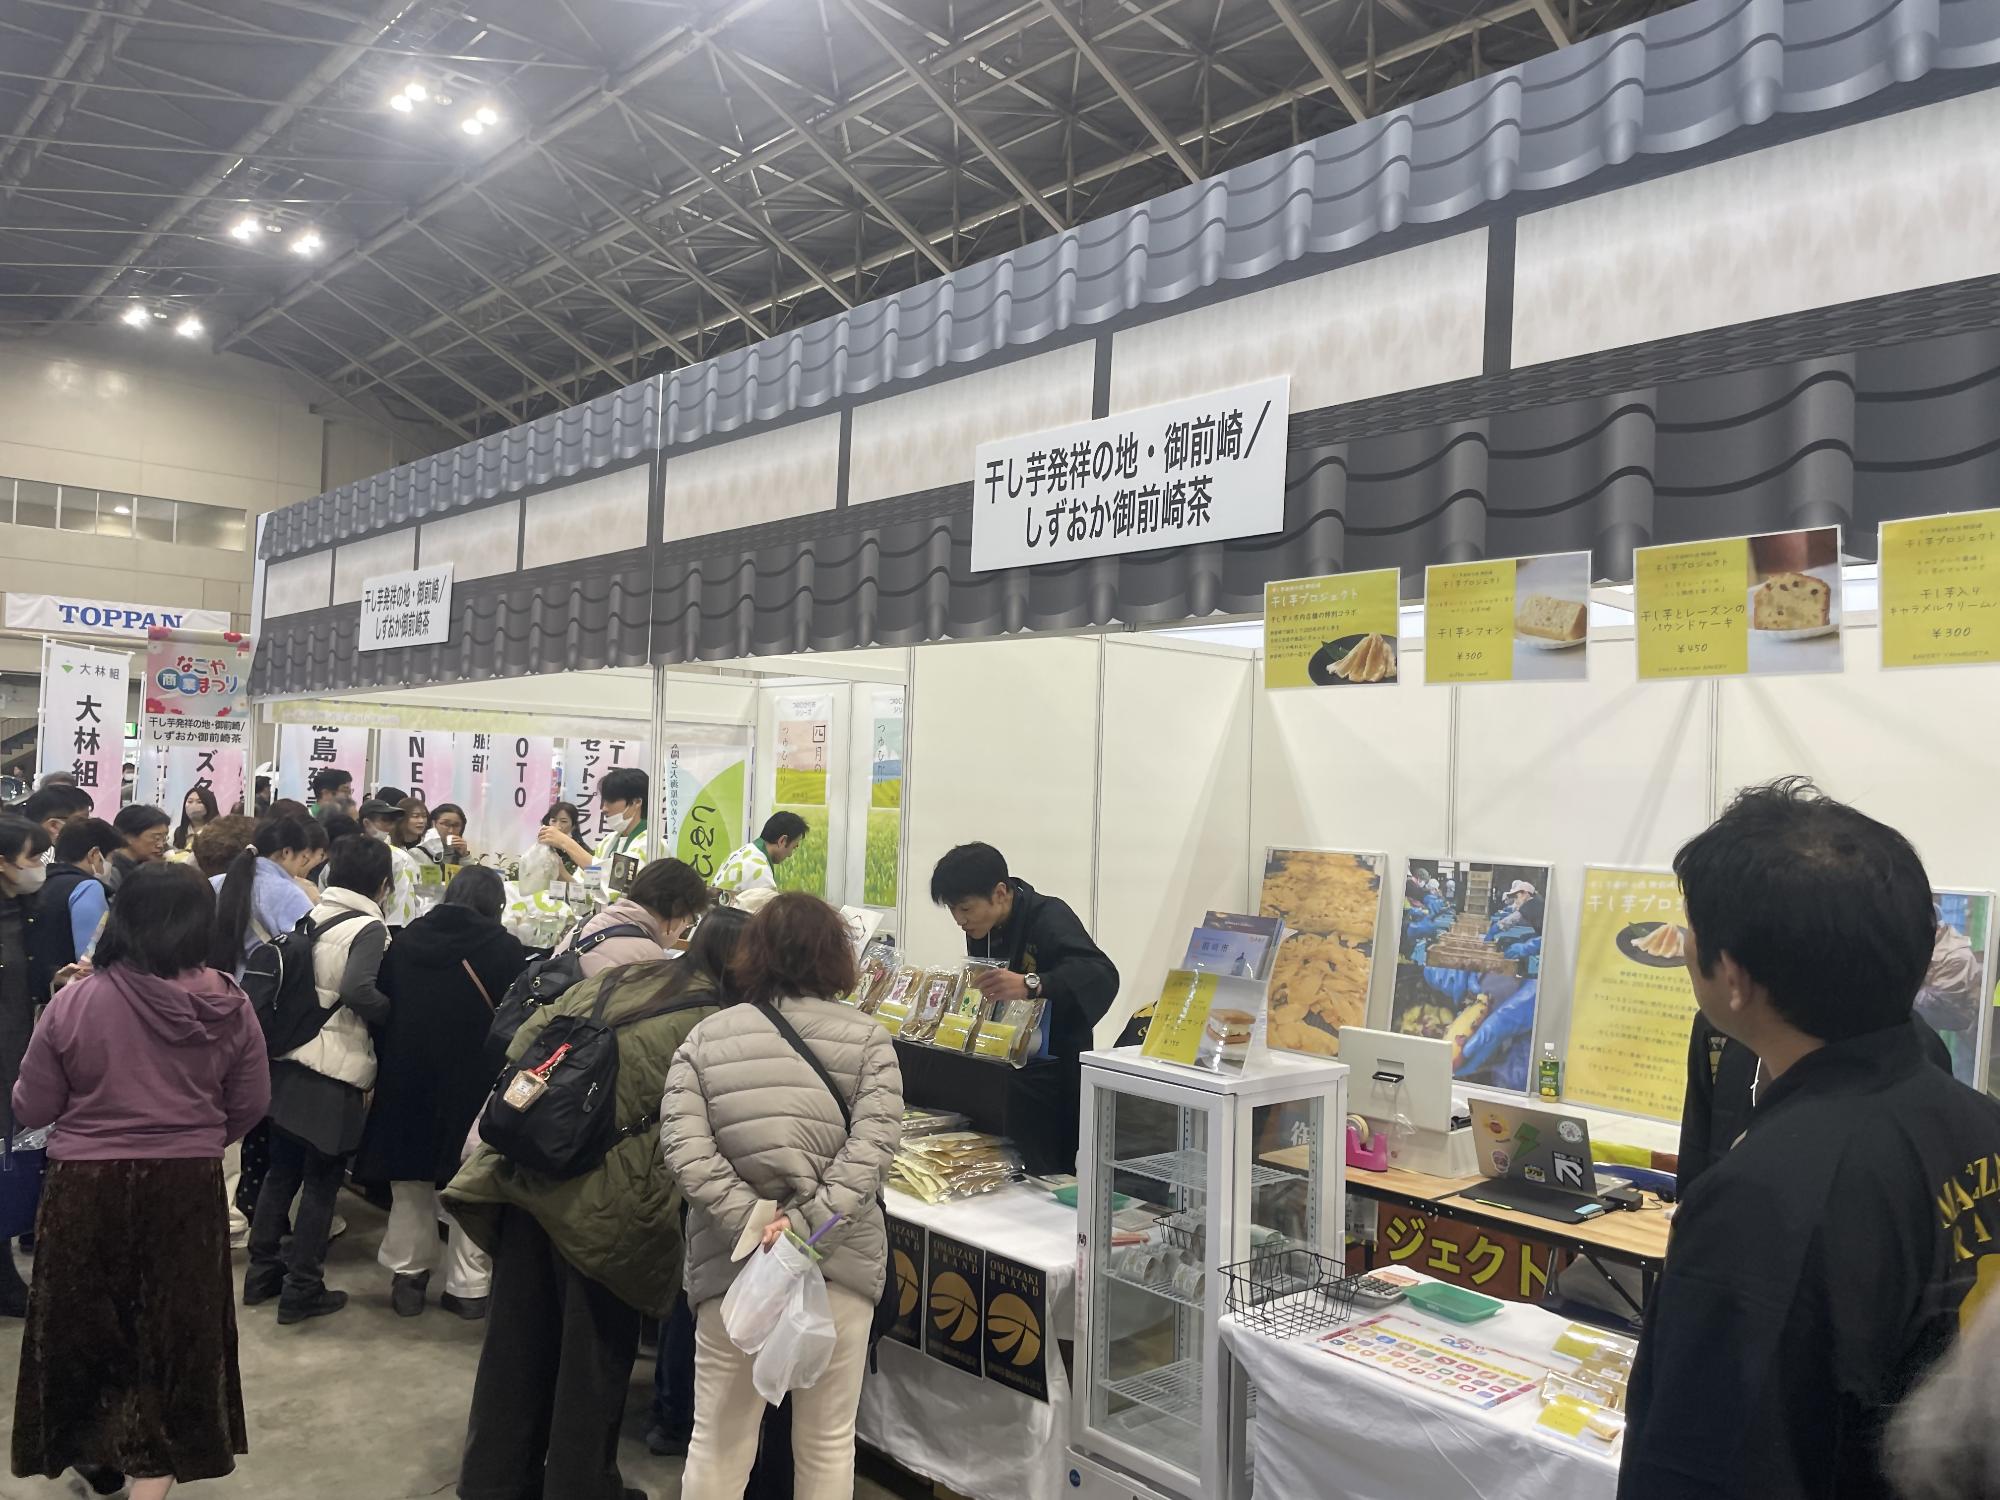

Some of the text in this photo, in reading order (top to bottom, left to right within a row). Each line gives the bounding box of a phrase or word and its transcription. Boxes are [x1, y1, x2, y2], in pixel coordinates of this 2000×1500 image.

[985, 400, 1271, 504] 干し芋発祥の地・御前崎／
[1026, 475, 1213, 547] しずおか御前崎茶
[365, 575, 447, 614] 干し芋発祥の地・御前崎／
[1920, 586, 1981, 600] 干し芋入り
[59, 605, 183, 629] TOPPAN
[1641, 604, 1745, 622] 干し芋とレーズンの
[1890, 601, 2000, 615] キャラメルクリーム
[376, 609, 430, 640] しずおか御前崎茶
[1437, 626, 1504, 640] 干し芋シフォン
[1931, 626, 1971, 639] ¥300
[1456, 651, 1483, 662] ¥300
[1677, 643, 1708, 654] ¥450
[80, 664, 120, 680] 大林組
[149, 717, 245, 731] 干し芋発祥の地・御前崎/
[72, 695, 103, 788] 大林組
[153, 731, 242, 744] しずおか御前崎茶
[409, 730, 426, 804] NED
[933, 1240, 978, 1264] OMAEZAKI
[933, 1250, 978, 1275] BRAND
[1386, 1217, 1547, 1297] ジェクト
[990, 1260, 1039, 1286] OMAEZAKI
[990, 1270, 1039, 1297] BRAND
